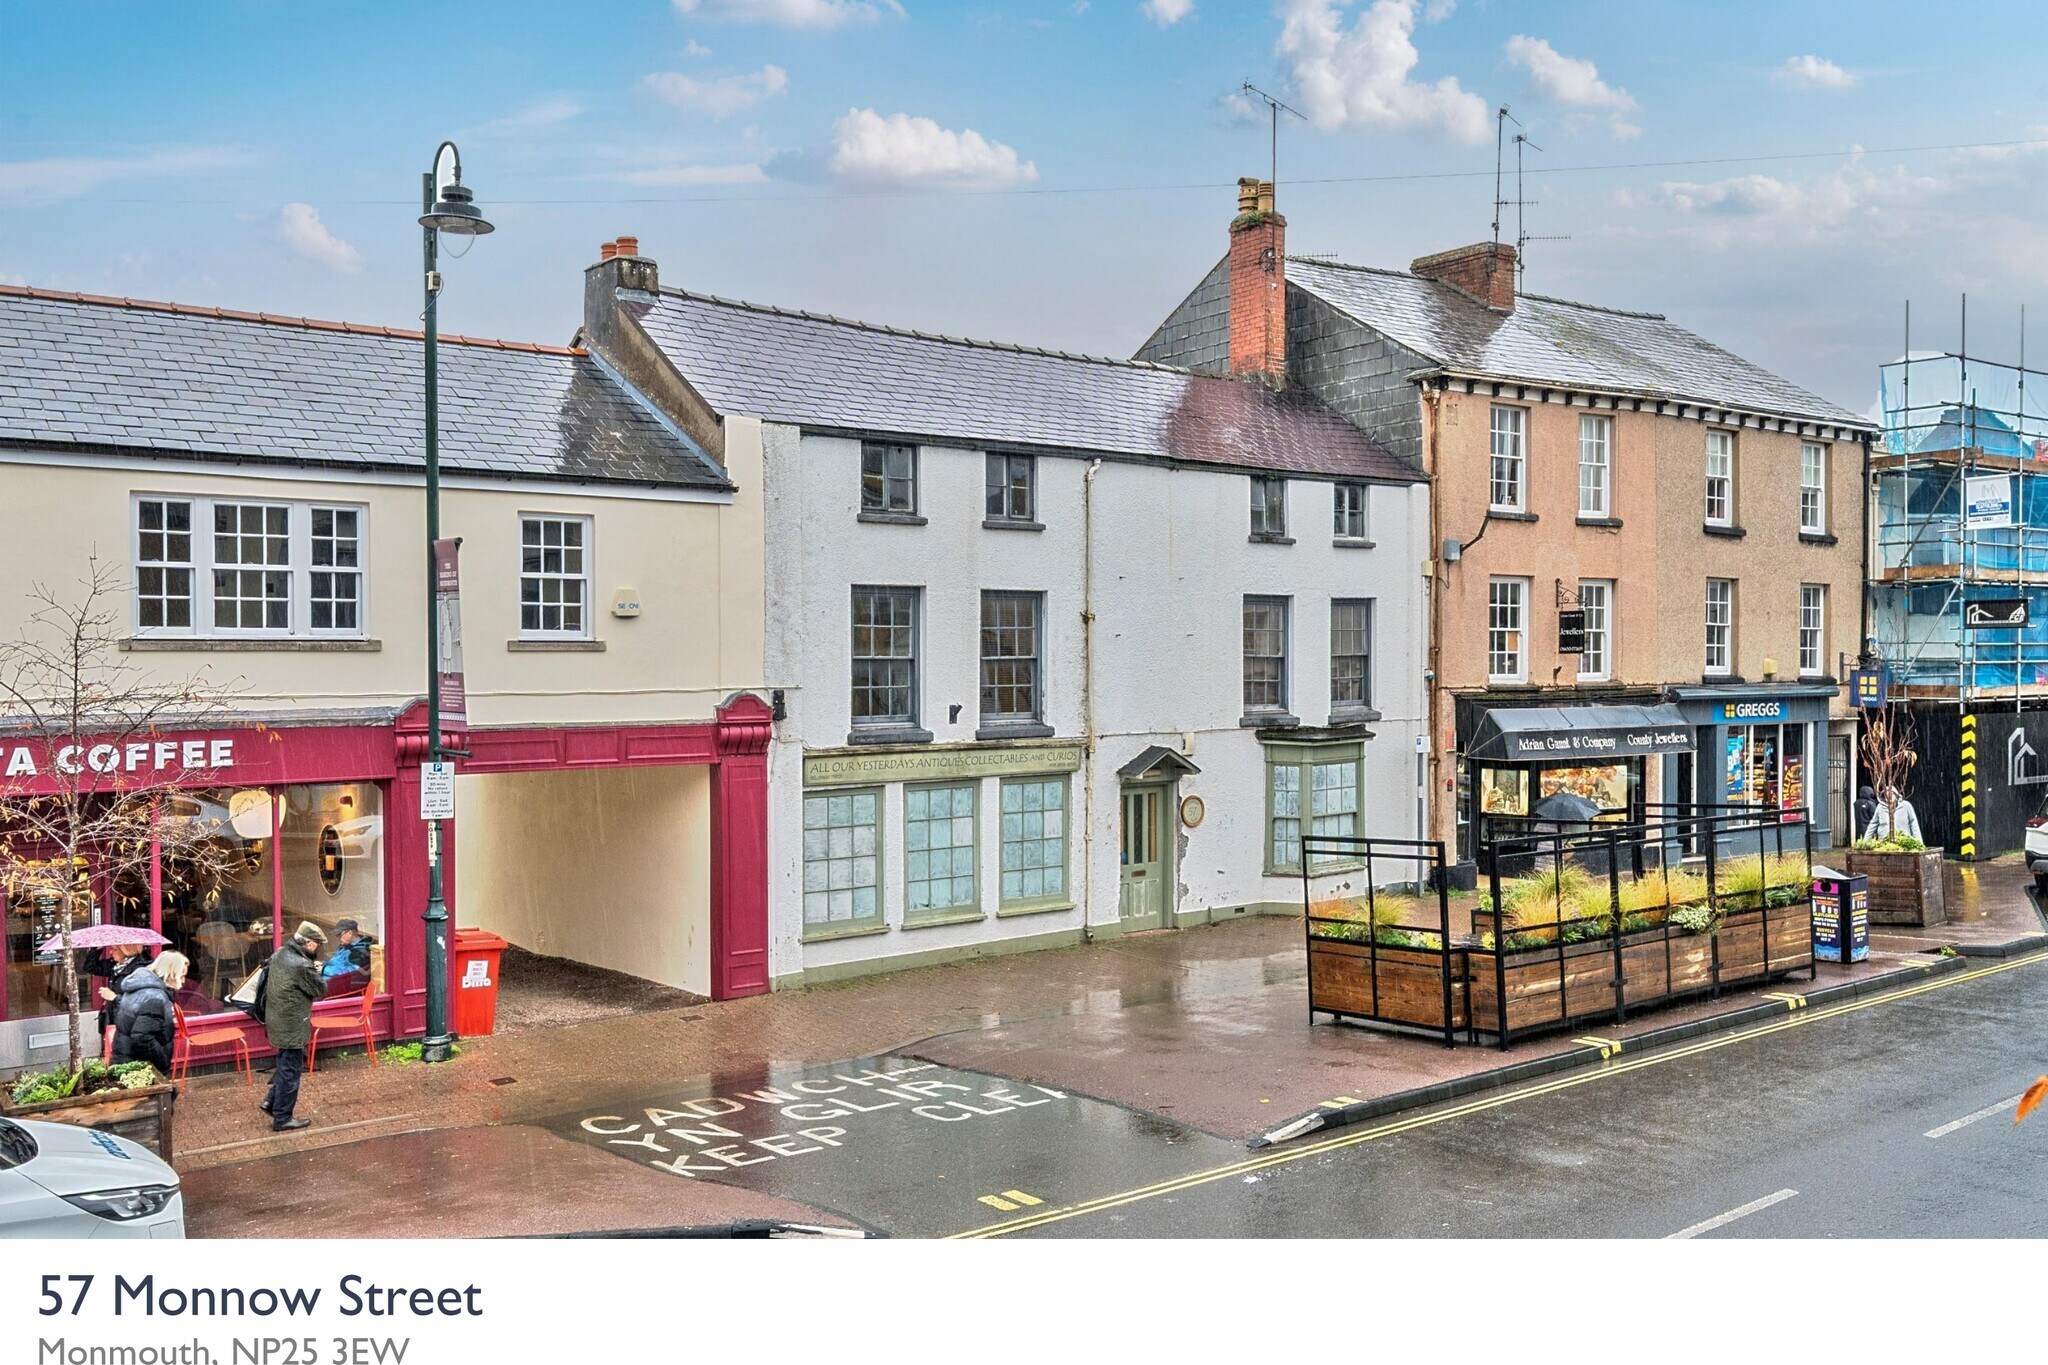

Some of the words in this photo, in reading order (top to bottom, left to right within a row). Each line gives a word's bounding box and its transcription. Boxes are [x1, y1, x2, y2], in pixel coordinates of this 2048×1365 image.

[1736, 702, 1780, 718] GREGGS
[1518, 738, 1545, 751] Adrian
[1546, 737, 1571, 750] Gaunt
[1572, 736, 1581, 748] &
[1582, 735, 1616, 750] Company
[1627, 733, 1652, 748] County
[1654, 731, 1688, 745] Jewellers
[56, 739, 234, 774] COFFEE
[810, 762, 830, 774] ALL
[831, 761, 855, 773] OUR
[856, 758, 915, 771] YESTERDAYS
[916, 756, 964, 769] ANTIQUES
[964, 753, 1029, 766] COLLECTABLES
[1046, 751, 1077, 762] CURIOS
[1188, 806, 1198, 817] 57
[580, 1067, 900, 1135] CADWCH
[607, 1121, 744, 1154] YN
[780, 1079, 973, 1122] GLIR
[649, 1125, 848, 1178] KEEP
